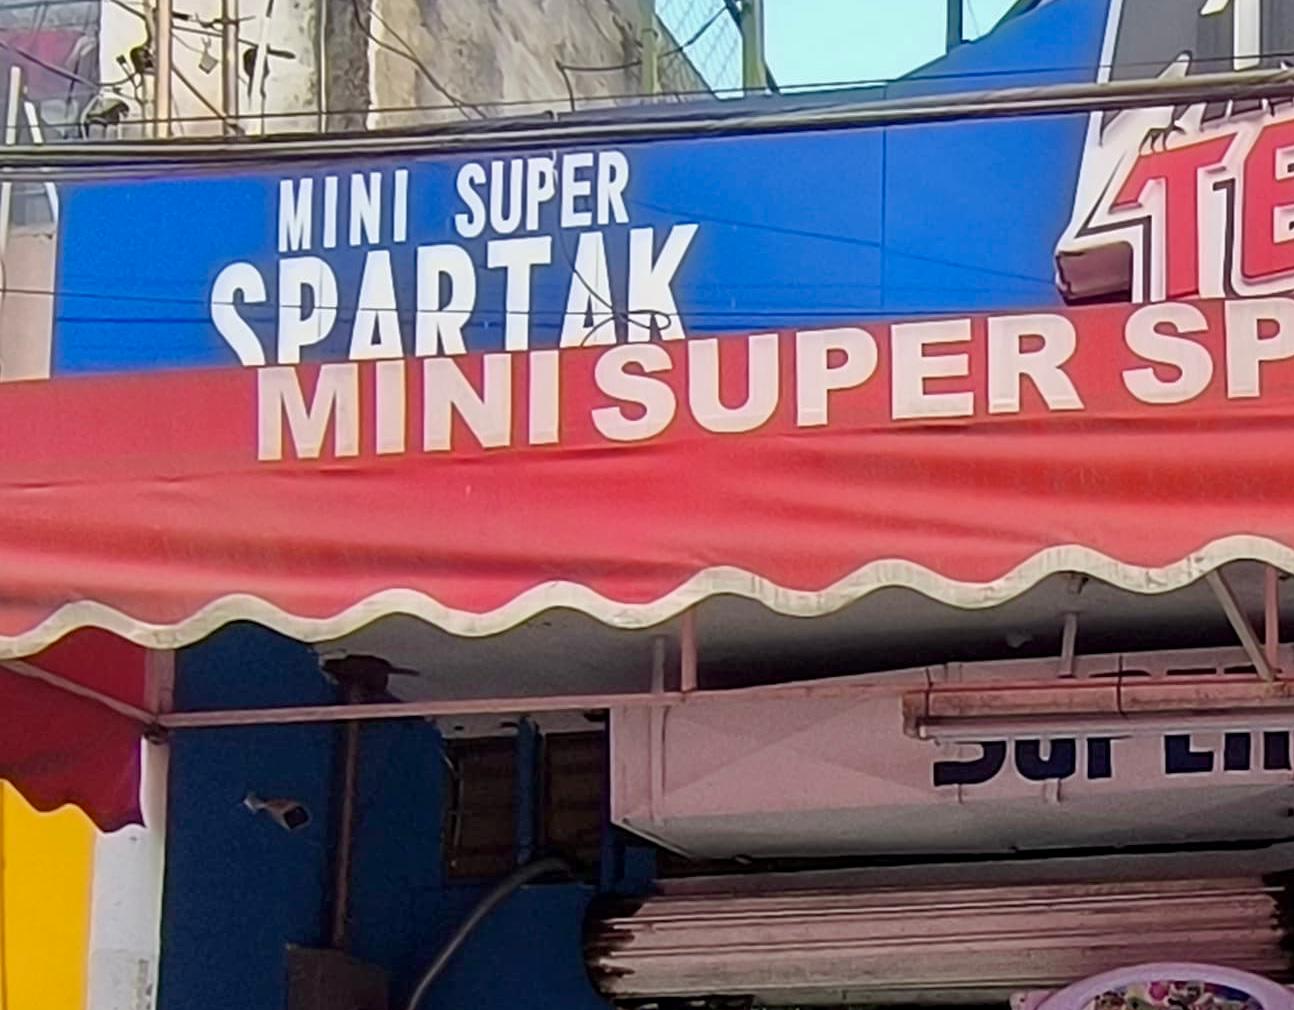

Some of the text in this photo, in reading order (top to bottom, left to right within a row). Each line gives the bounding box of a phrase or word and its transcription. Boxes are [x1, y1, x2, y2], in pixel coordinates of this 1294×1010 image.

[279, 150, 629, 252] MINI SUPER
[210, 223, 700, 365] SPARTAK
[257, 347, 560, 462] MINI
[591, 313, 1084, 442] SUPER
